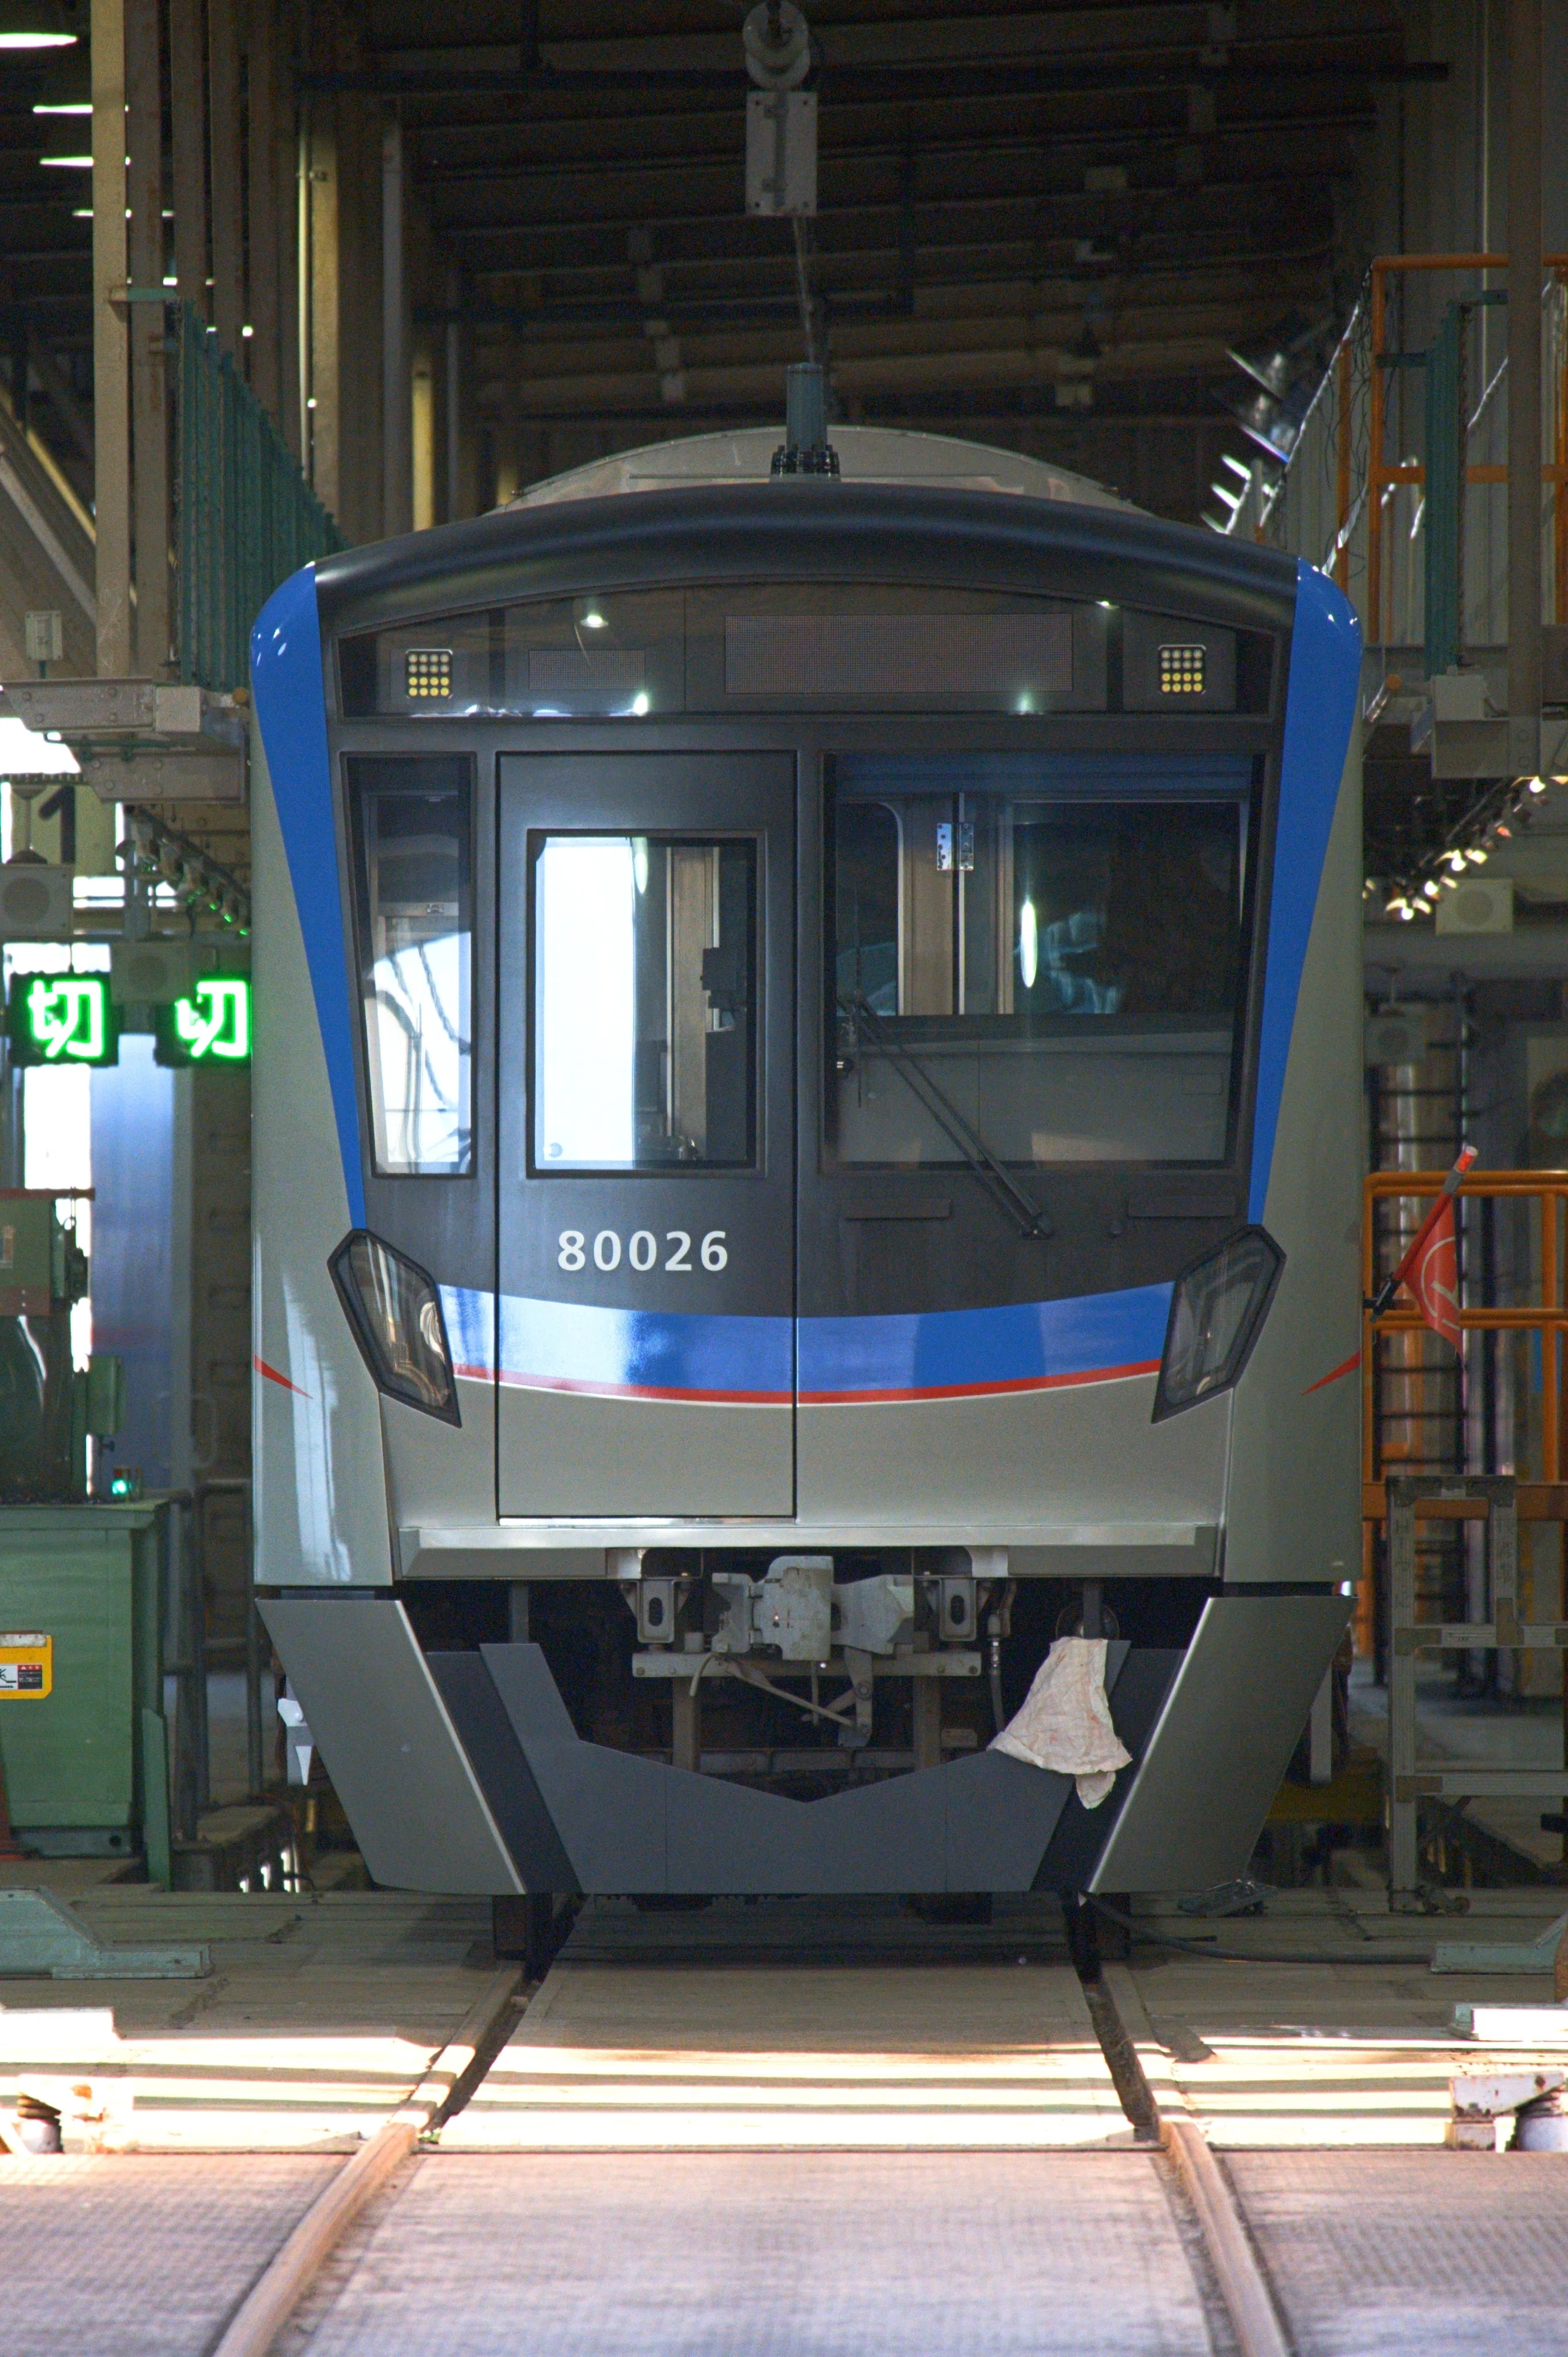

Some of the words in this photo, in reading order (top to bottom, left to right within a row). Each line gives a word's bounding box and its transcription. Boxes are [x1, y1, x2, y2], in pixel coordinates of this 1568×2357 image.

[38, 784, 75, 864] 1
[28, 979, 104, 1058] 切
[175, 980, 247, 1058] 切
[557, 1230, 728, 1271] 80026
